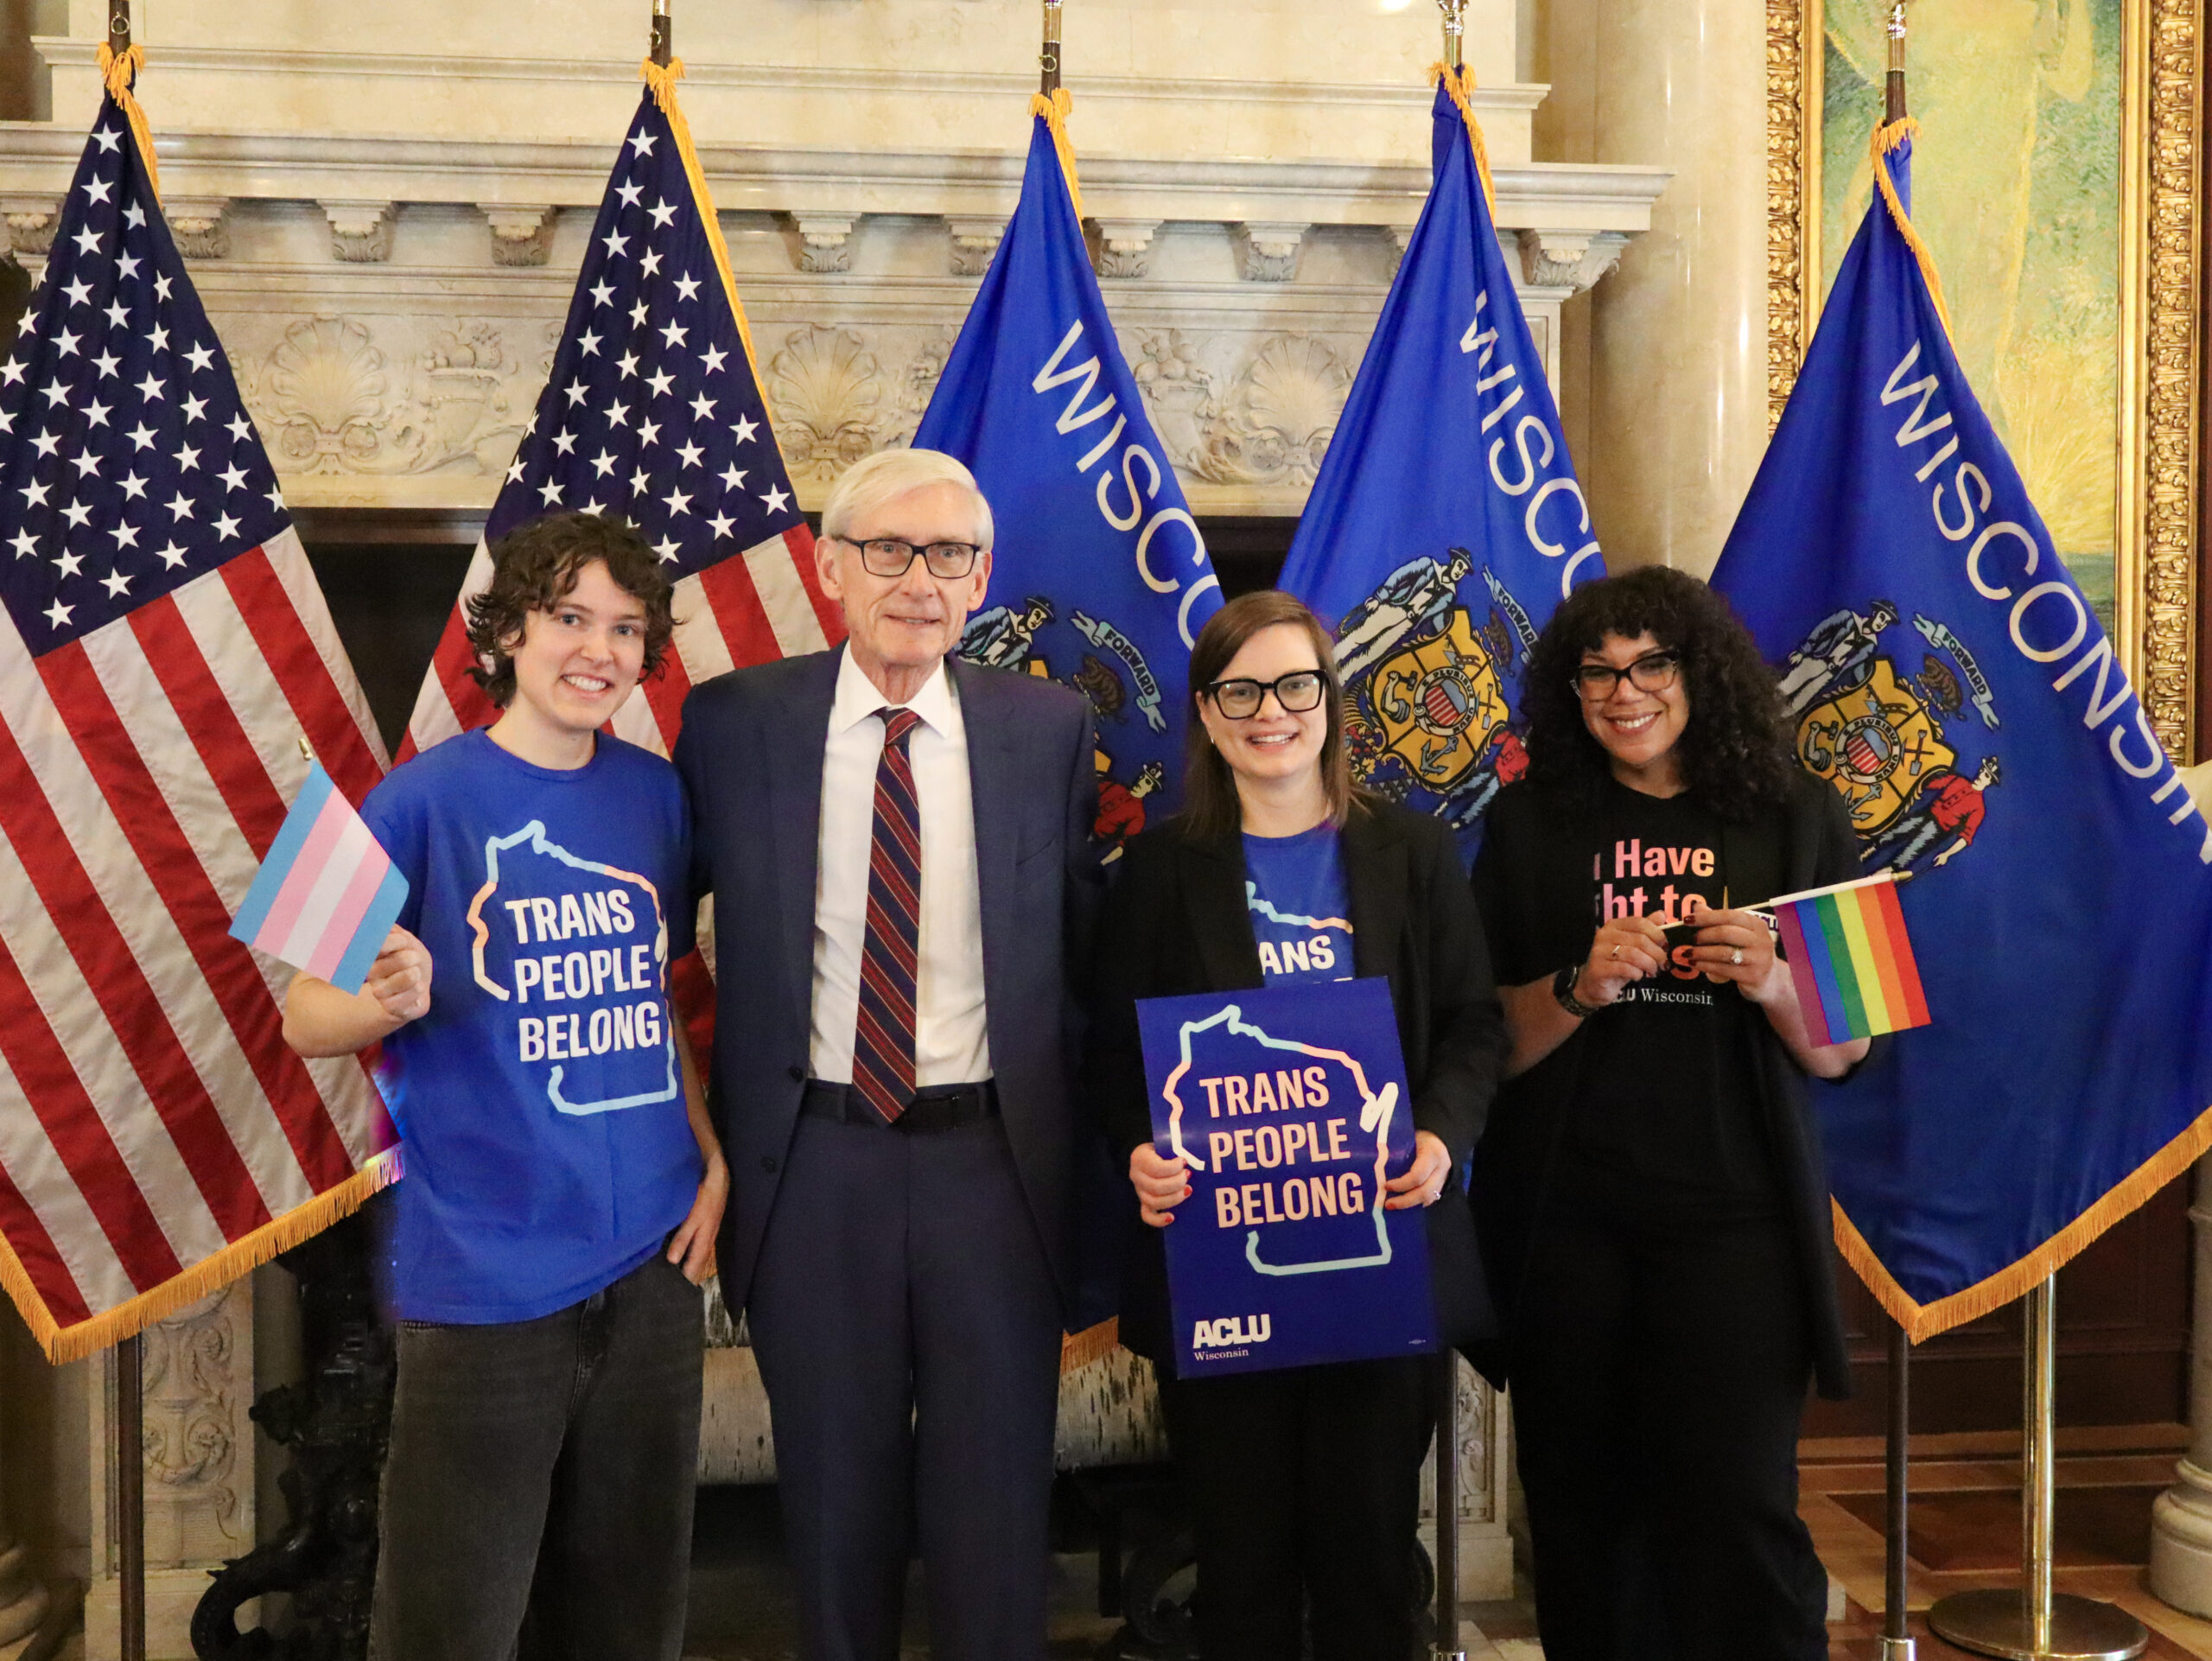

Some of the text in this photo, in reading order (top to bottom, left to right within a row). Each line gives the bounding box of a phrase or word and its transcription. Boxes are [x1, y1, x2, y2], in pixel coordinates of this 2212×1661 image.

[1497, 588, 1535, 646] FORWAR
[1103, 629, 1155, 696] FORWARD
[1942, 632, 1986, 695] FORWARD
[1615, 838, 1715, 879] Have
[505, 888, 635, 945] TRANS
[514, 944, 652, 1004] PEOPLE
[1258, 935, 1335, 976] ANS
[518, 1001, 661, 1062] BELONG
[1199, 1066, 1330, 1118] TRANS
[1209, 1117, 1351, 1174] PEOPLE
[1215, 1172, 1364, 1229] BELONG
[1192, 1314, 1271, 1349] ACLU
[1193, 1347, 1249, 1362] Wisconsin
